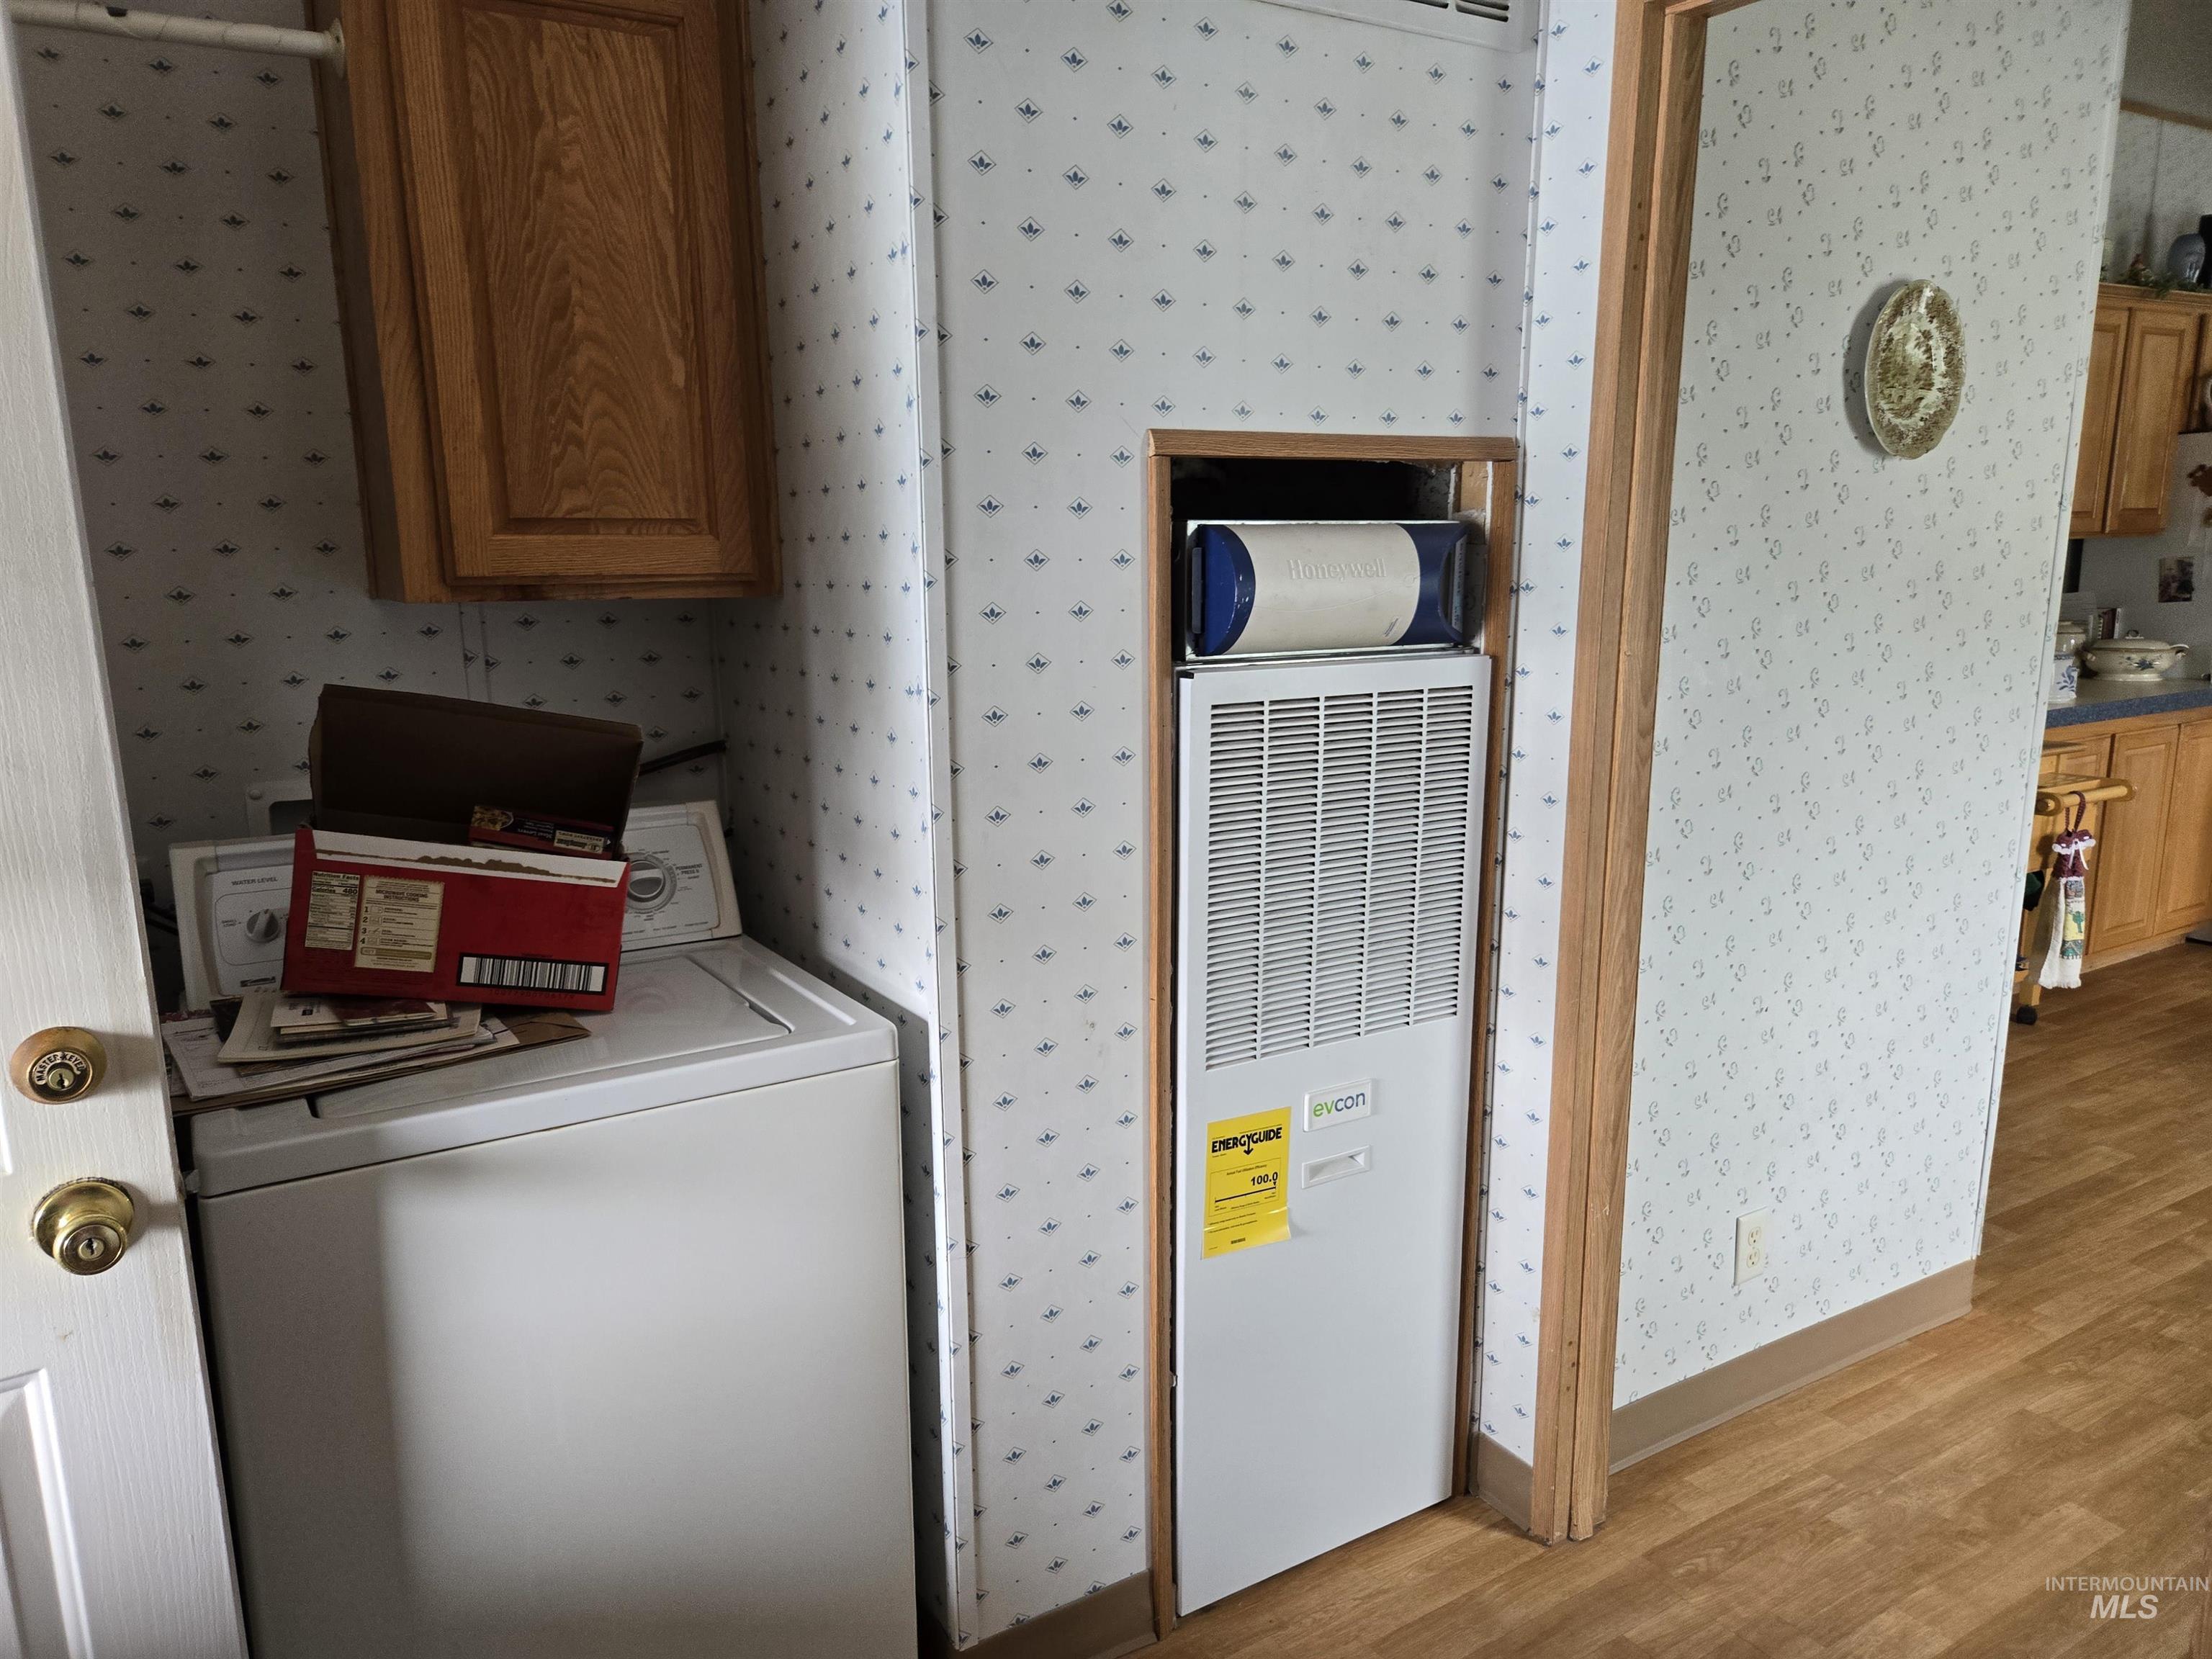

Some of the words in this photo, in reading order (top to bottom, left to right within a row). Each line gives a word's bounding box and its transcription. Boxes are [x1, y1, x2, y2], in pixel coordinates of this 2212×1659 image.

[1287, 557, 1388, 582] Honeywell
[1313, 1090, 1366, 1118] evcon
[1211, 1127, 1282, 1154] ENERGYGUIDE
[1250, 1172, 1278, 1186] 100.0
